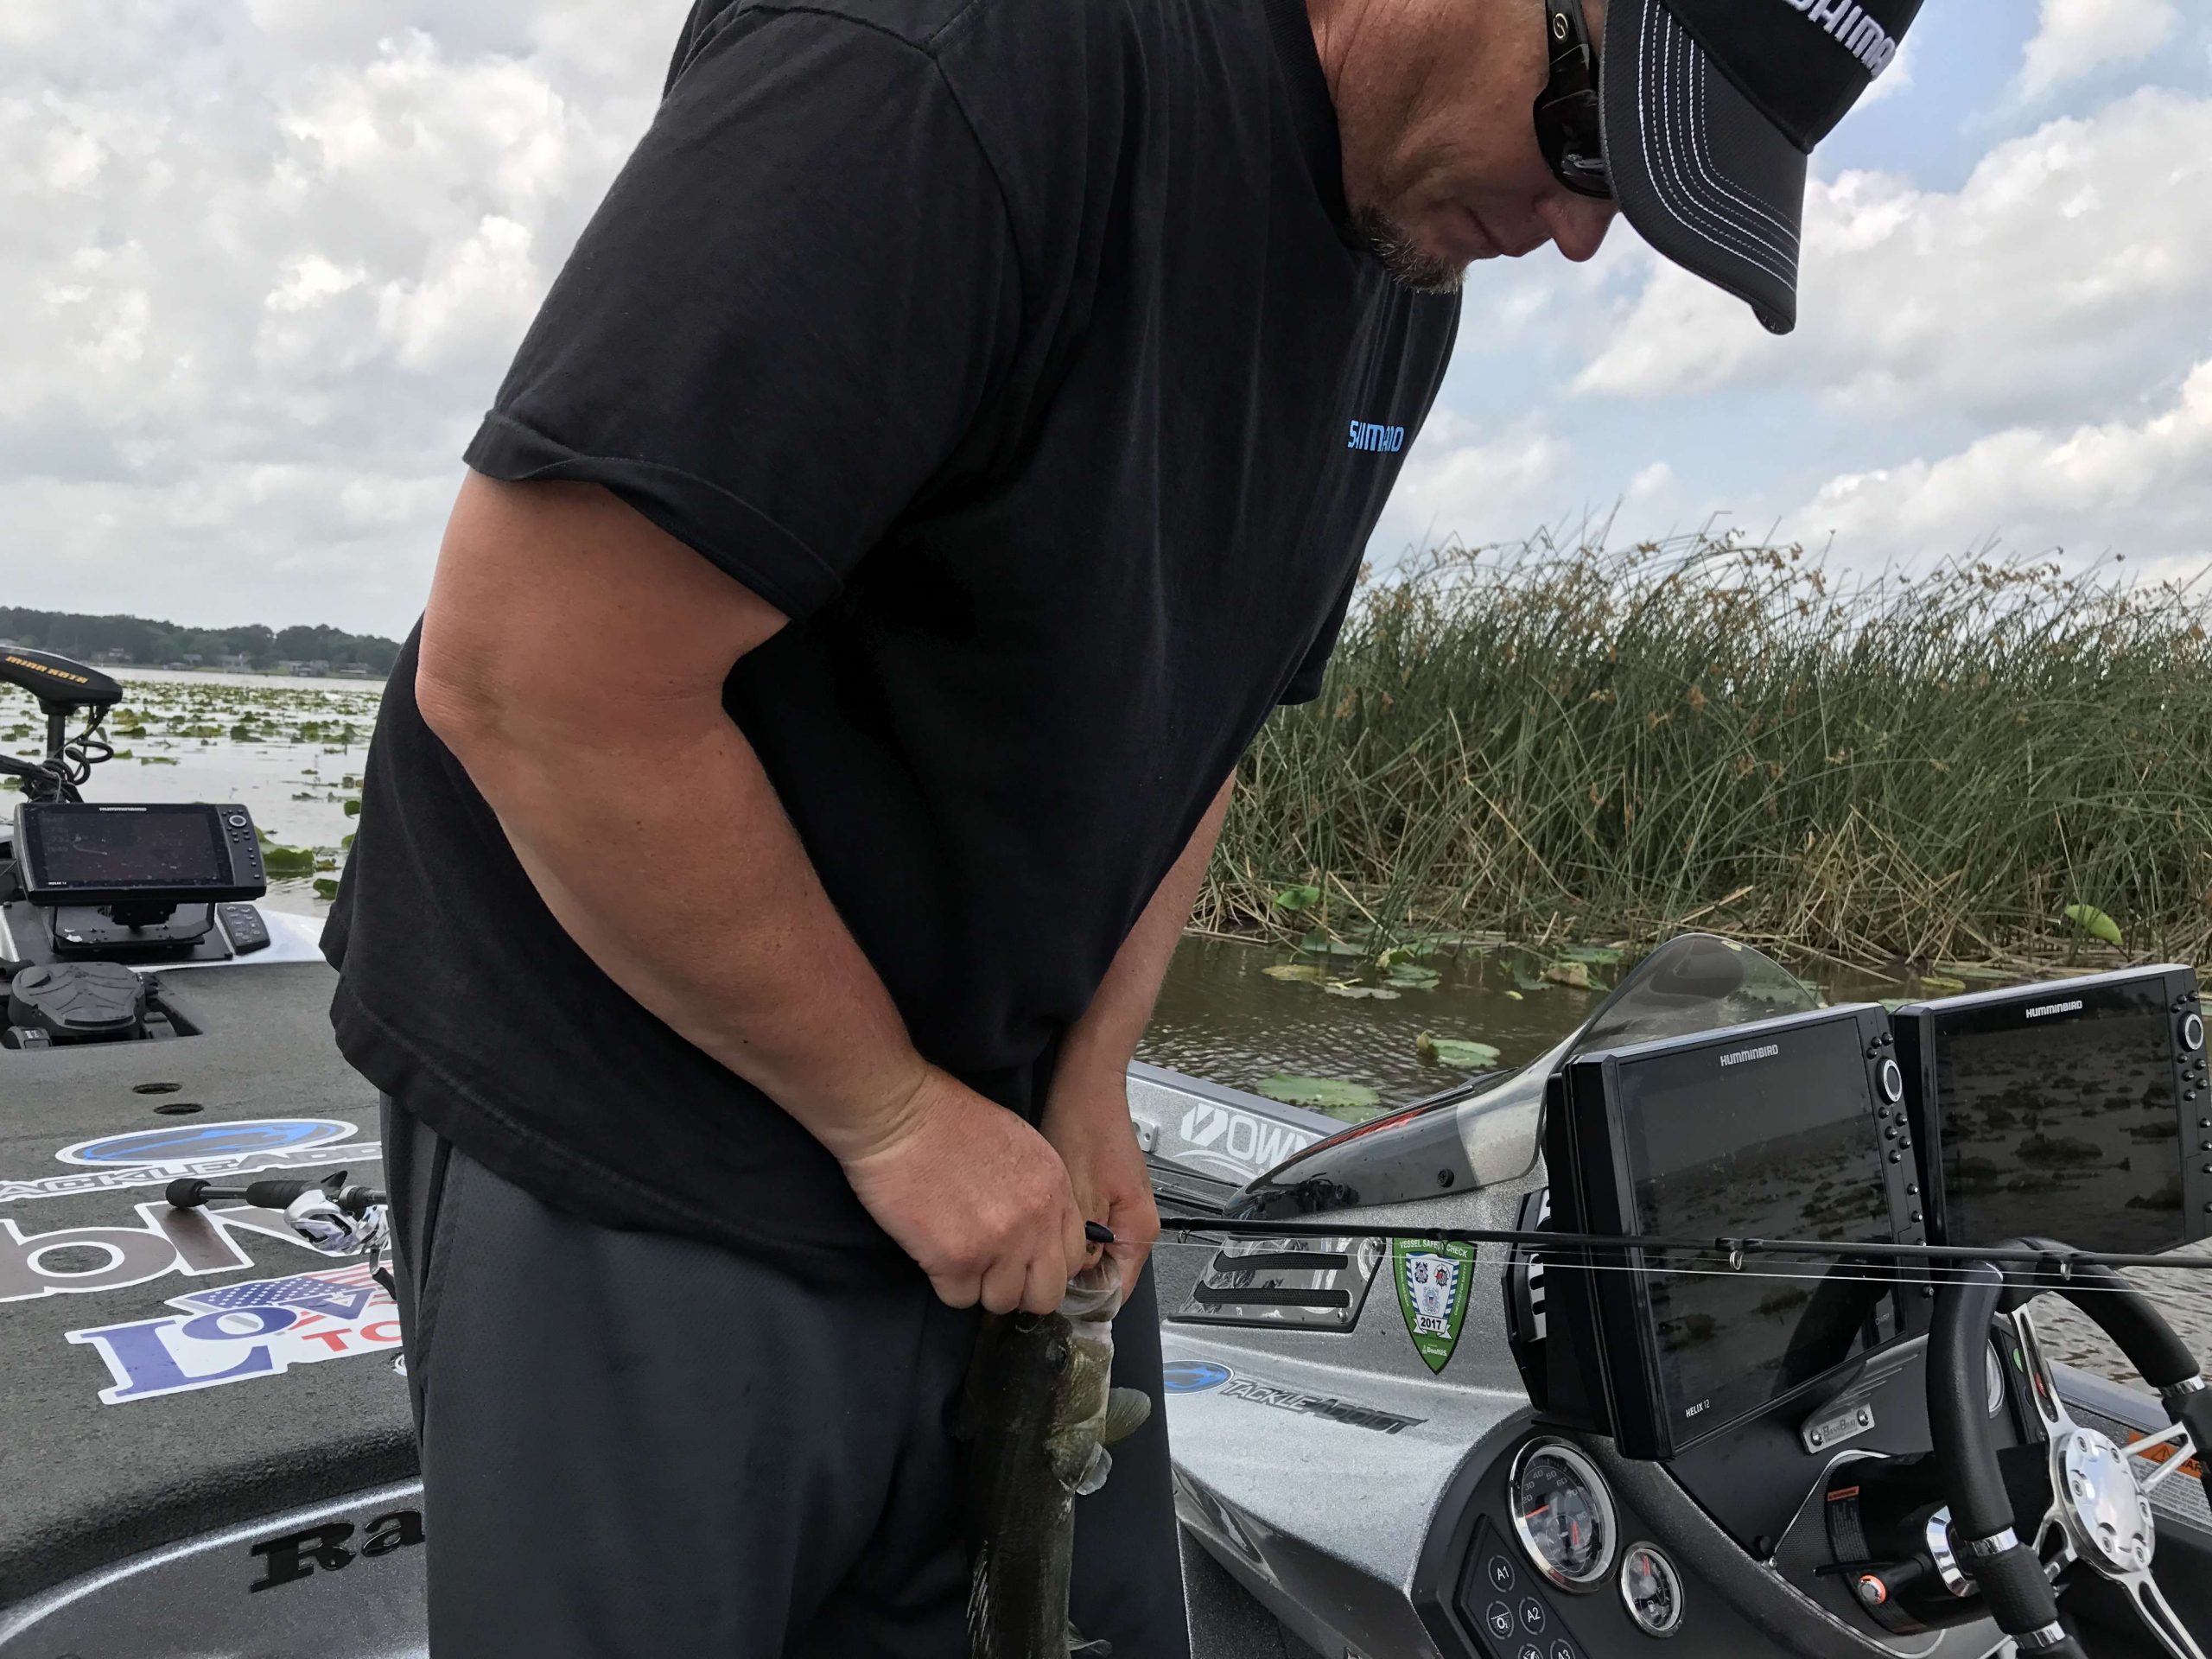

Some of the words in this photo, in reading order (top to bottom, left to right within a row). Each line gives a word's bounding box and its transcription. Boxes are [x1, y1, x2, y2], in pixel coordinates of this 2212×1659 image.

[5, 656, 48, 672] MINN
[48, 668, 89, 683] KOTA
[2024, 1000, 2083, 1019] HUMMINBIRD
[1719, 1044, 1779, 1066] HUMMINBIRD
[1399, 1238, 1422, 1249] VESSEL
[1446, 1243, 1468, 1258] CHECK
[1420, 1317, 1442, 1331] 2017
[1685, 1402, 1704, 1418] HELIX
[1703, 1398, 1711, 1409] 12
[1532, 1469, 1544, 1480] 40
[1545, 1470, 1558, 1480] 50
[1555, 1477, 1567, 1487] 60
[1524, 1481, 1535, 1491] 30
[1522, 1493, 1534, 1504] 20
[1497, 1565, 1510, 1581] A1
[1527, 1606, 1541, 1623] A2
[1558, 1649, 1571, 1659] A3
